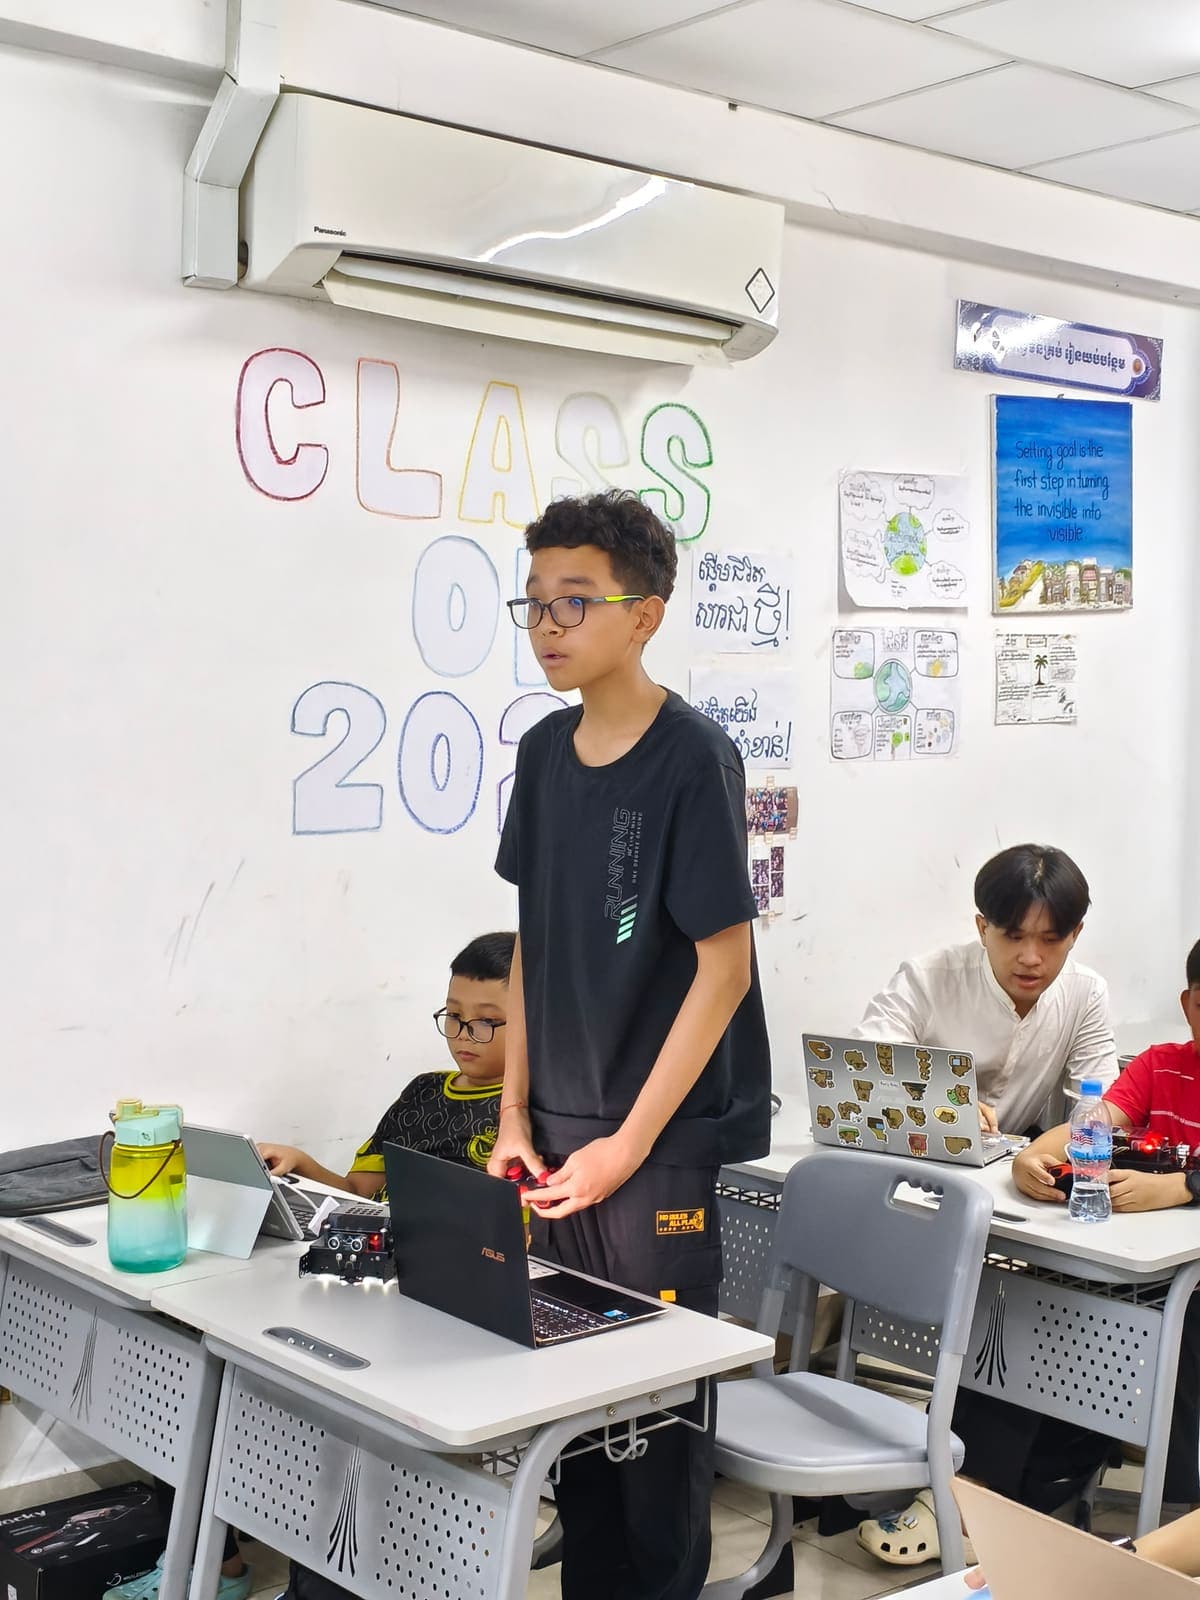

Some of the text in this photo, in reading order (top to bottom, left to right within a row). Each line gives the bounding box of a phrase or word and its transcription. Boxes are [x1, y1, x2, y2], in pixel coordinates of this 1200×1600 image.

[313, 225, 347, 237] Panasonic
[235, 346, 714, 543] CLASS
[1015, 439, 1104, 470] Setting goal is the
[1014, 469, 1109, 500] first step in turning
[1014, 497, 1102, 521] the invisible into
[604, 807, 631, 920] RUNNING
[481, 1247, 506, 1264] ASUS
